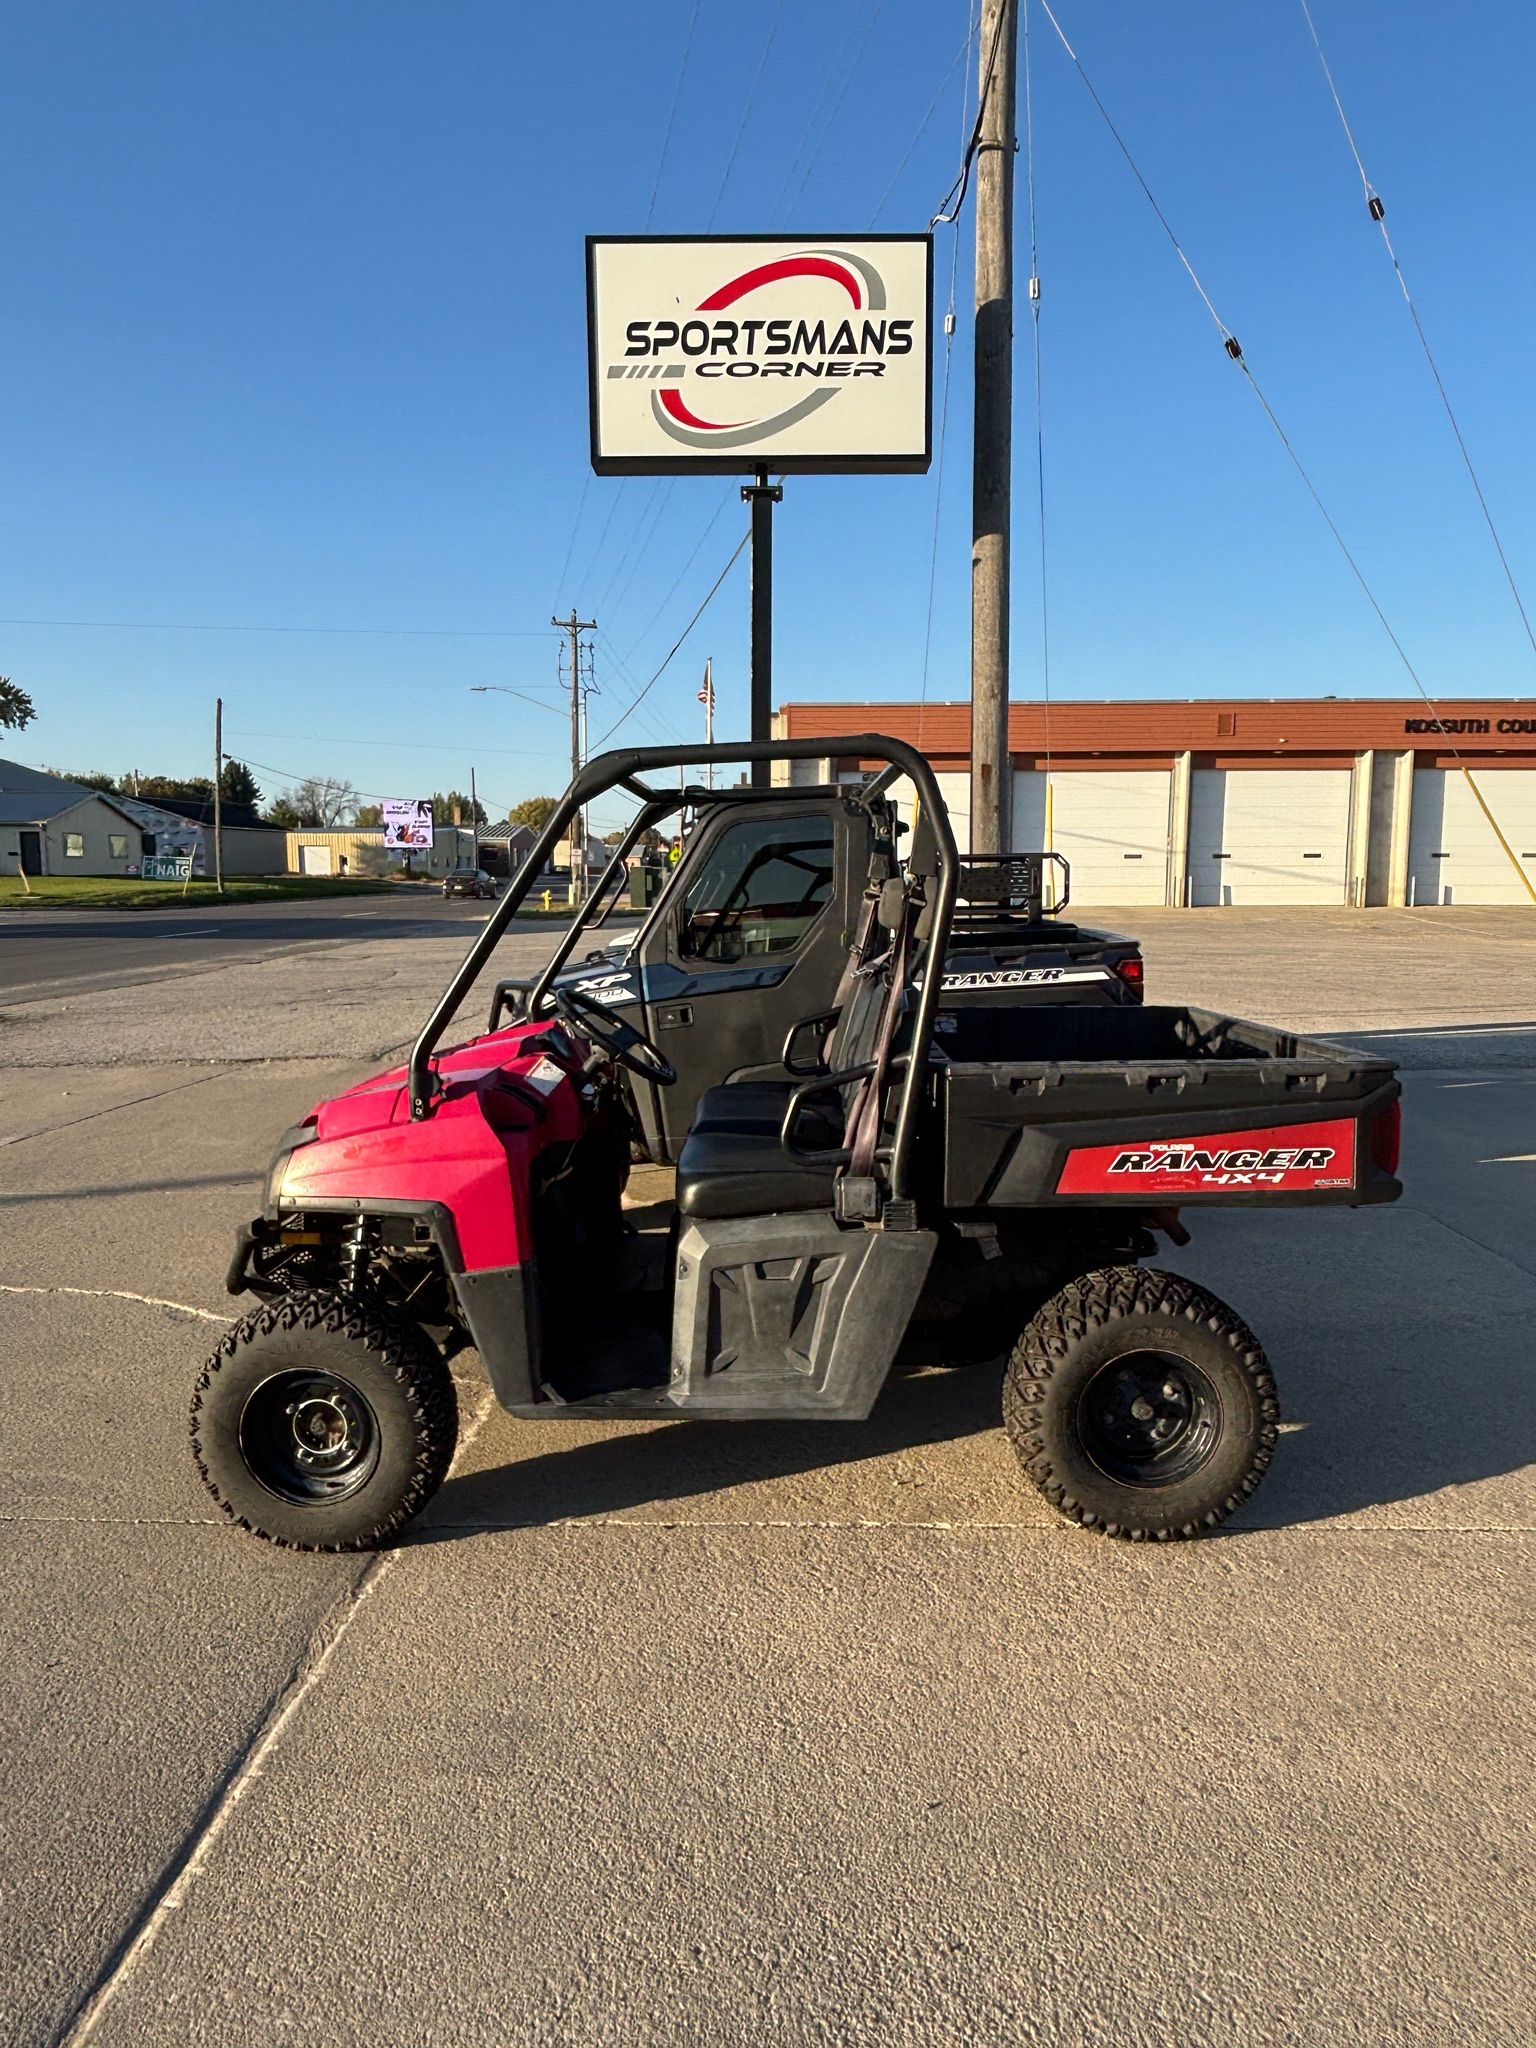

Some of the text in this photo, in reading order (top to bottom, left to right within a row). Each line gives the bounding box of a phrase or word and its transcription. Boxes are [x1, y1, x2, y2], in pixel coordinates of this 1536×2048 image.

[624, 319, 914, 356] SPORTSMANS
[695, 361, 886, 378] CORNER
[1405, 719, 1490, 733] KOSSUTH
[157, 864, 190, 877] NAIG
[575, 973, 632, 991] XP
[942, 968, 1064, 986] RANGER
[1107, 1148, 1335, 1172] RANGER
[1202, 1172, 1286, 1184] 4X4
